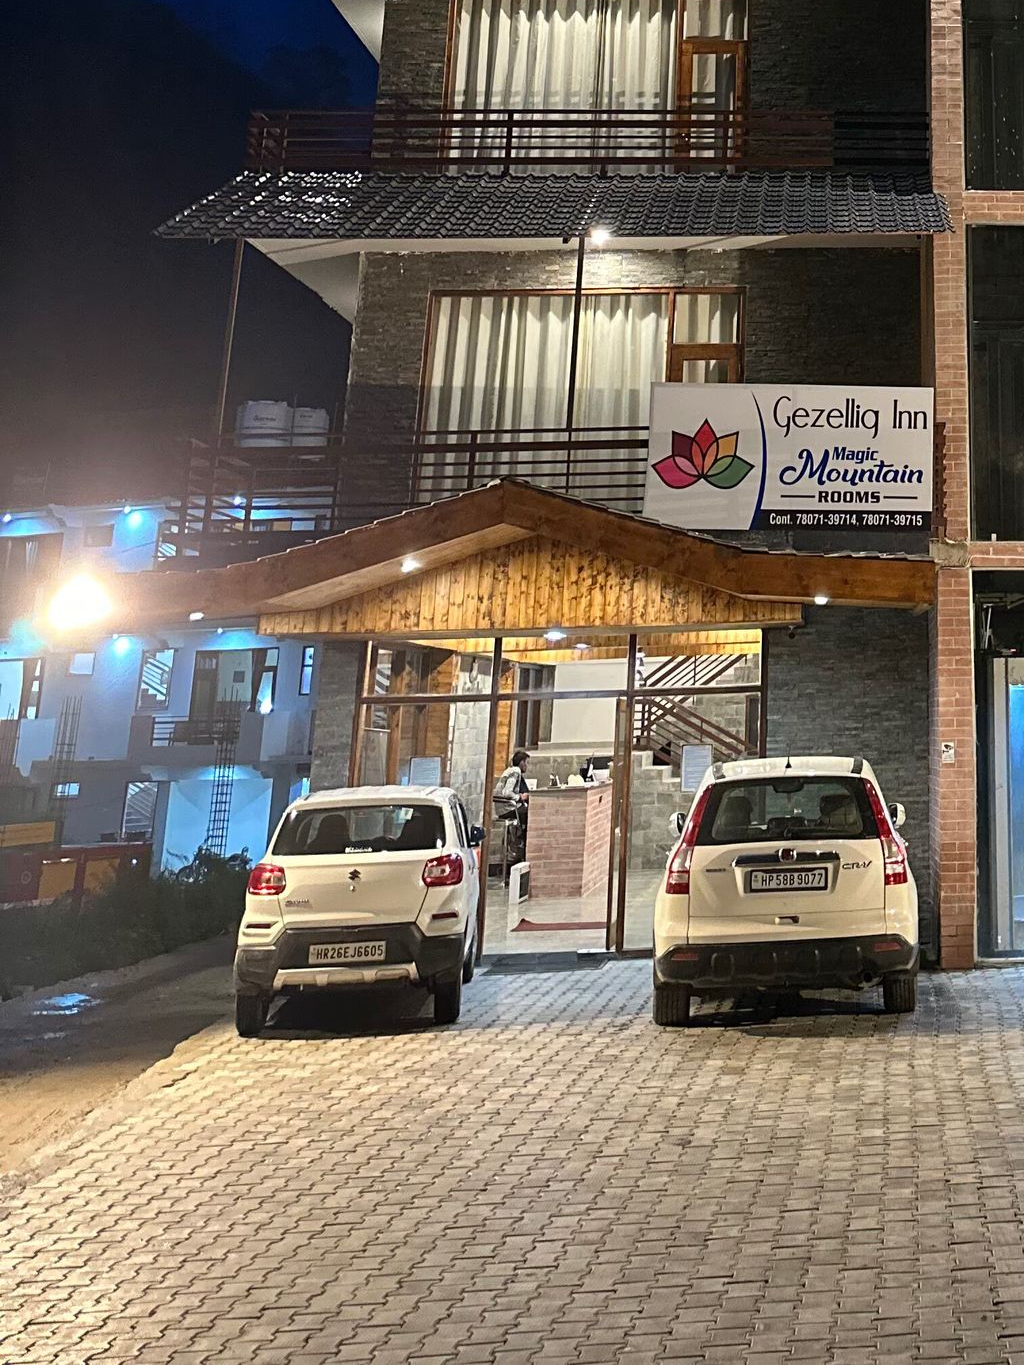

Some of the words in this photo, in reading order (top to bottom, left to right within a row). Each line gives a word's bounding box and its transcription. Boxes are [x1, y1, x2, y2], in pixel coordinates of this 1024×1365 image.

[773, 395, 880, 439] Gezellig
[892, 399, 927, 430] Inn
[832, 447, 878, 464] Magic
[779, 448, 924, 487] Mountain
[818, 491, 881, 504] ROOMS
[769, 513, 793, 525] Cont.
[796, 513, 859, 527] 78071-39714,
[862, 514, 923, 526] 78071-39715
[842, 860, 872, 870] CR-V
[761, 874, 774, 886] HP
[775, 874, 795, 886] 58B
[798, 873, 823, 885] 9077
[316, 945, 384, 960] HR26EJ6605
